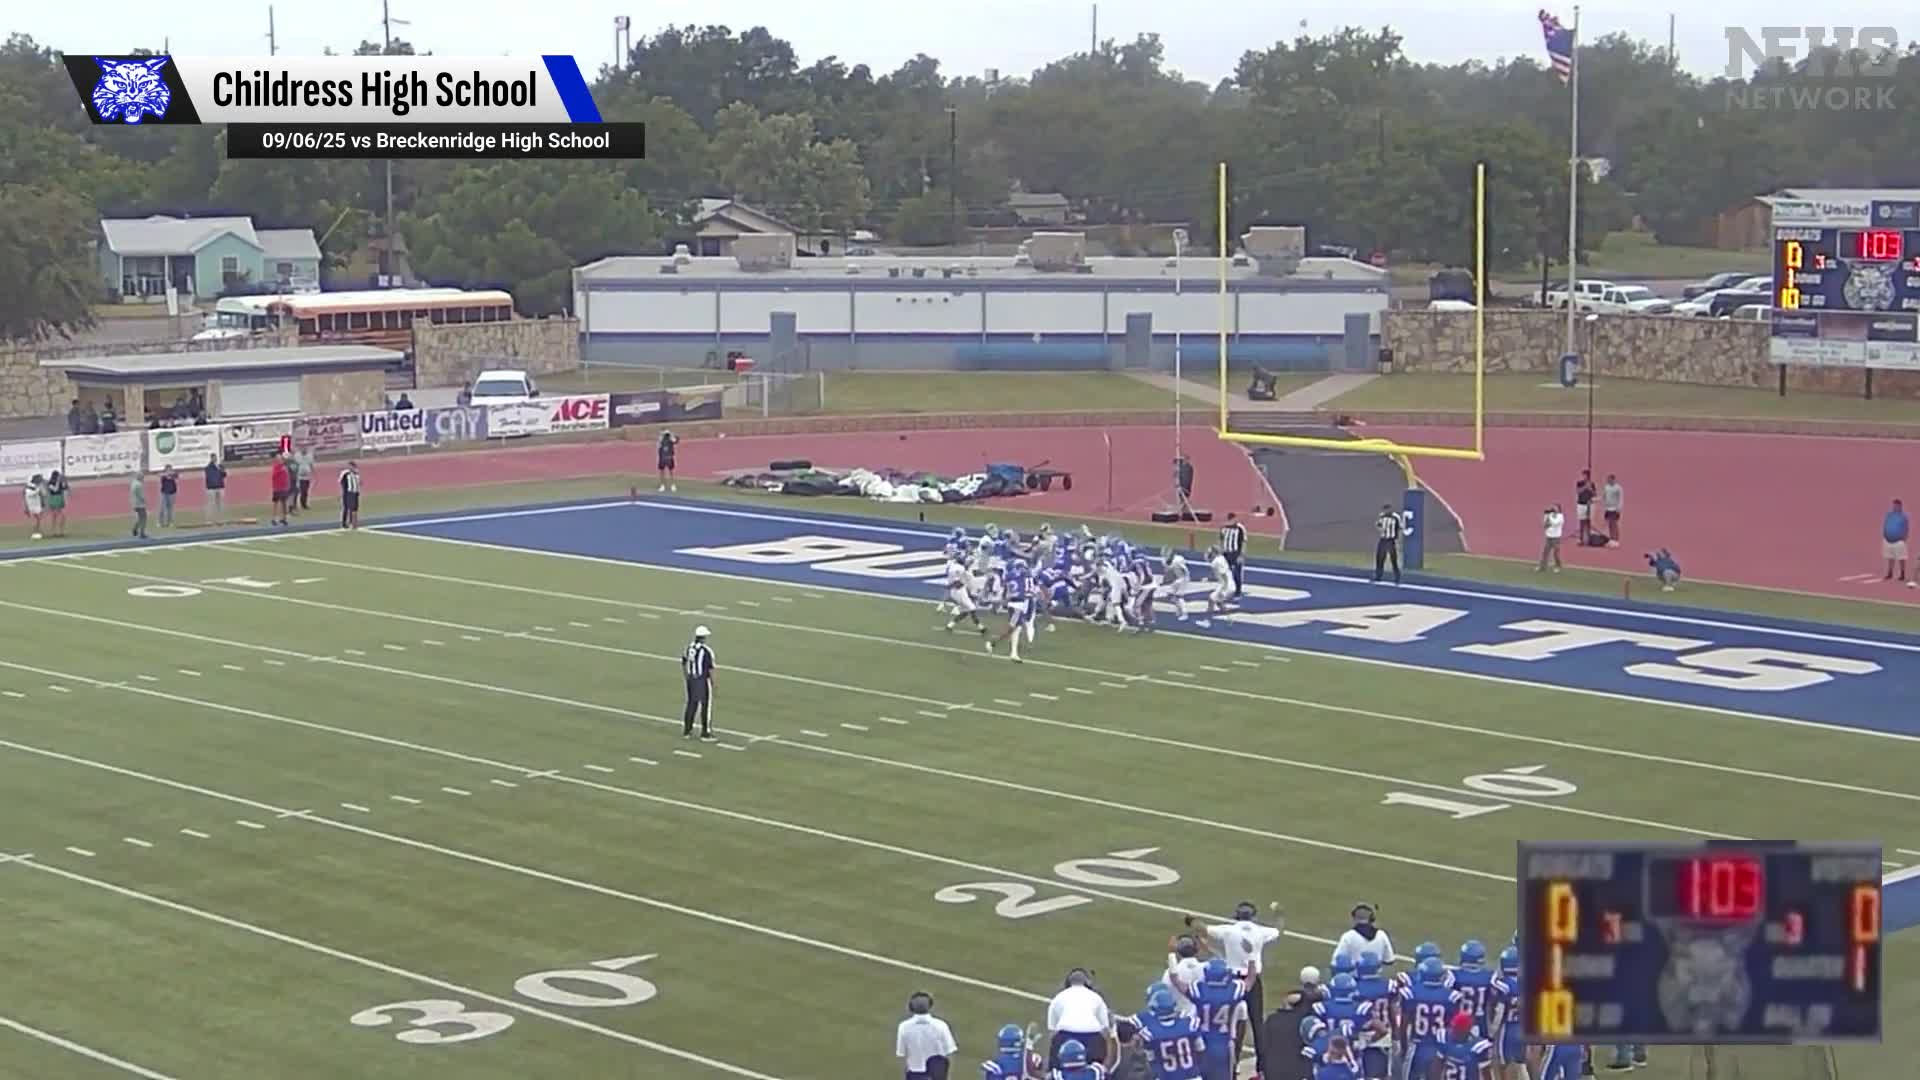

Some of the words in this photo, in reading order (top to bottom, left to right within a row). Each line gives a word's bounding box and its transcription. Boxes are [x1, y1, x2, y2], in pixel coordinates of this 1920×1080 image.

[1823, 203, 1869, 216] United
[1560, 355, 1578, 388] C
[362, 410, 422, 433] United
[551, 399, 608, 421] ACE
[1381, 772, 1577, 818] 10
[934, 857, 1181, 919] 20
[350, 969, 657, 1044] 30
[1202, 1004, 1229, 1033] 14
[1415, 1004, 1446, 1036] 63
[1160, 1038, 1193, 1073] 50
